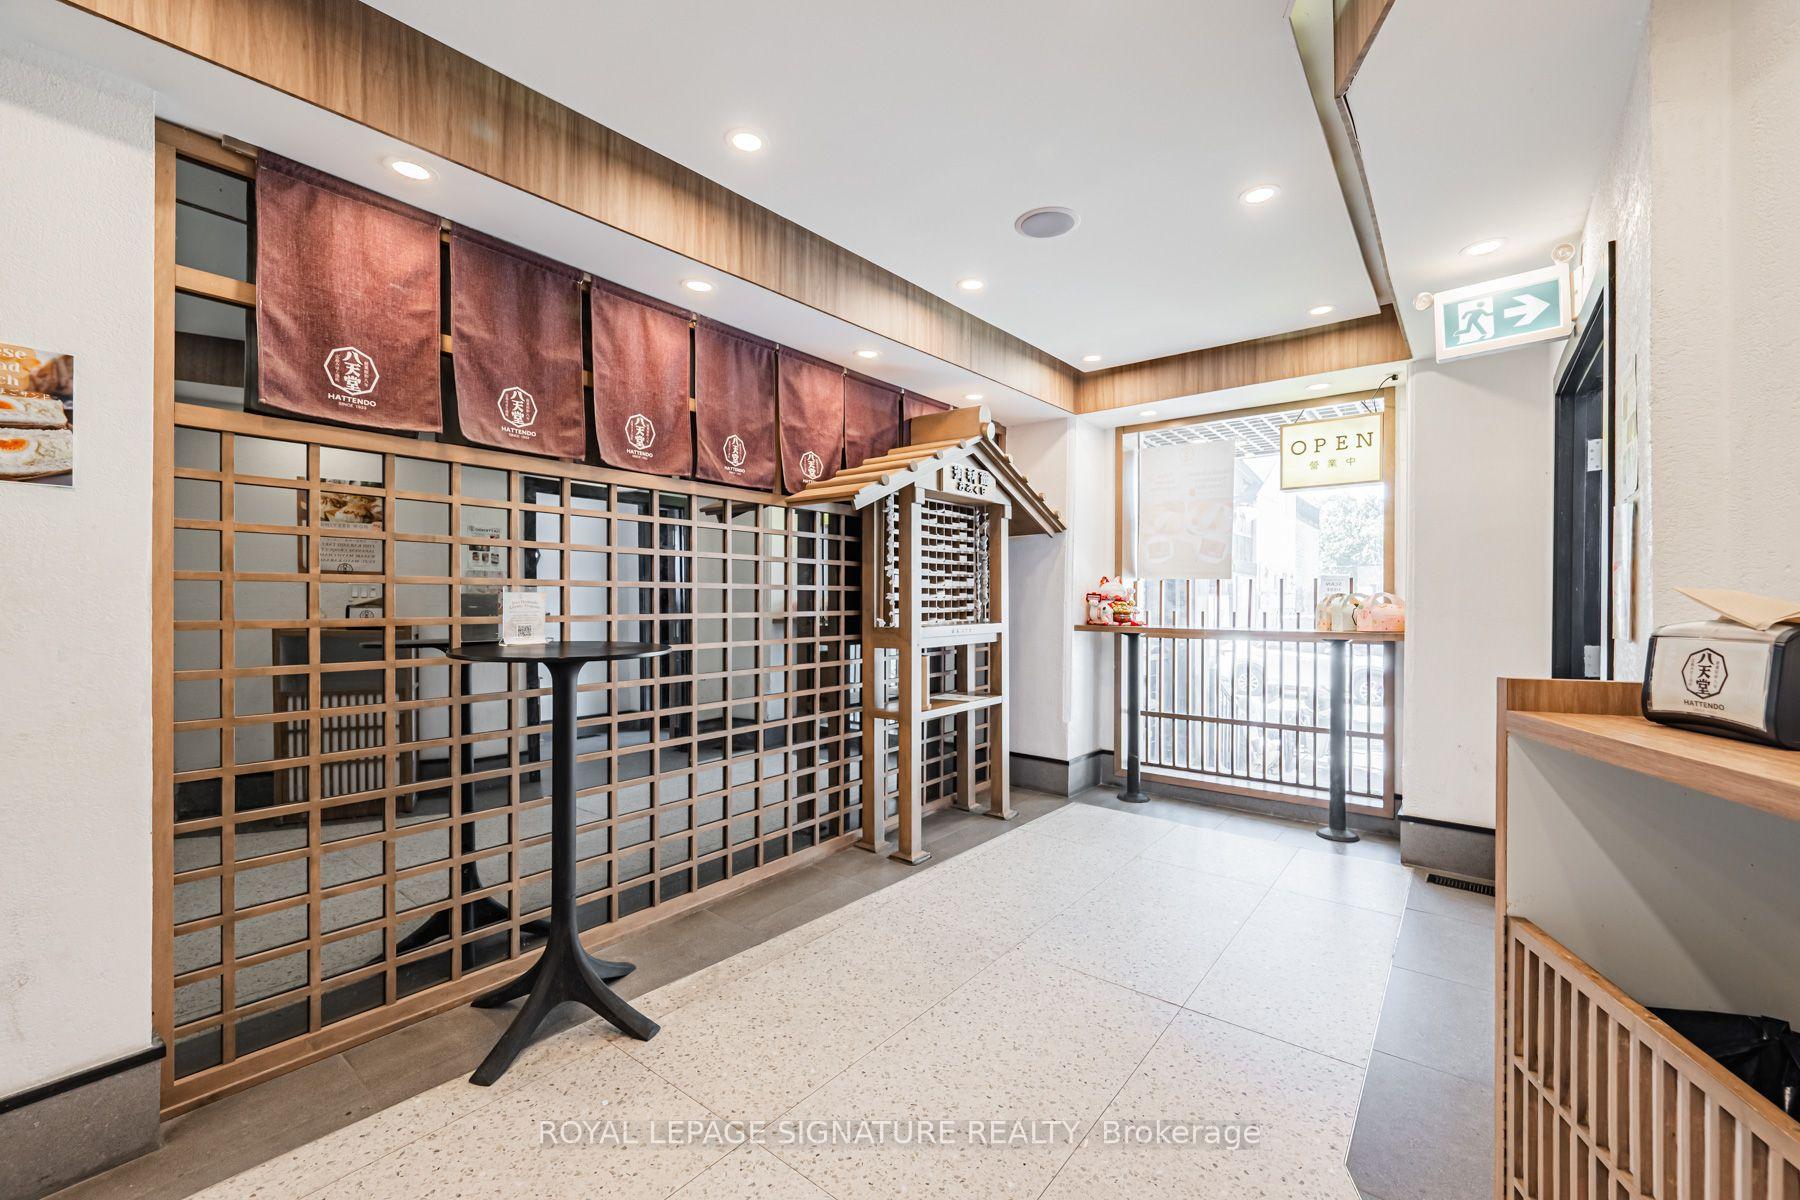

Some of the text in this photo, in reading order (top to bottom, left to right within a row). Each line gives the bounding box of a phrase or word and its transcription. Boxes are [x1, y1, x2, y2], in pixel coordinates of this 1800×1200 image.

[342, 351, 364, 393] 八天堂
[328, 392, 377, 407] HATTENDO
[510, 390, 525, 425] 八天堂
[501, 425, 537, 437] HATTENDO
[626, 448, 654, 458] HATTENDO
[1290, 431, 1374, 456] OPEN
[1695, 652, 1714, 696] 八天堂
[1683, 699, 1725, 711] HATTENDO
